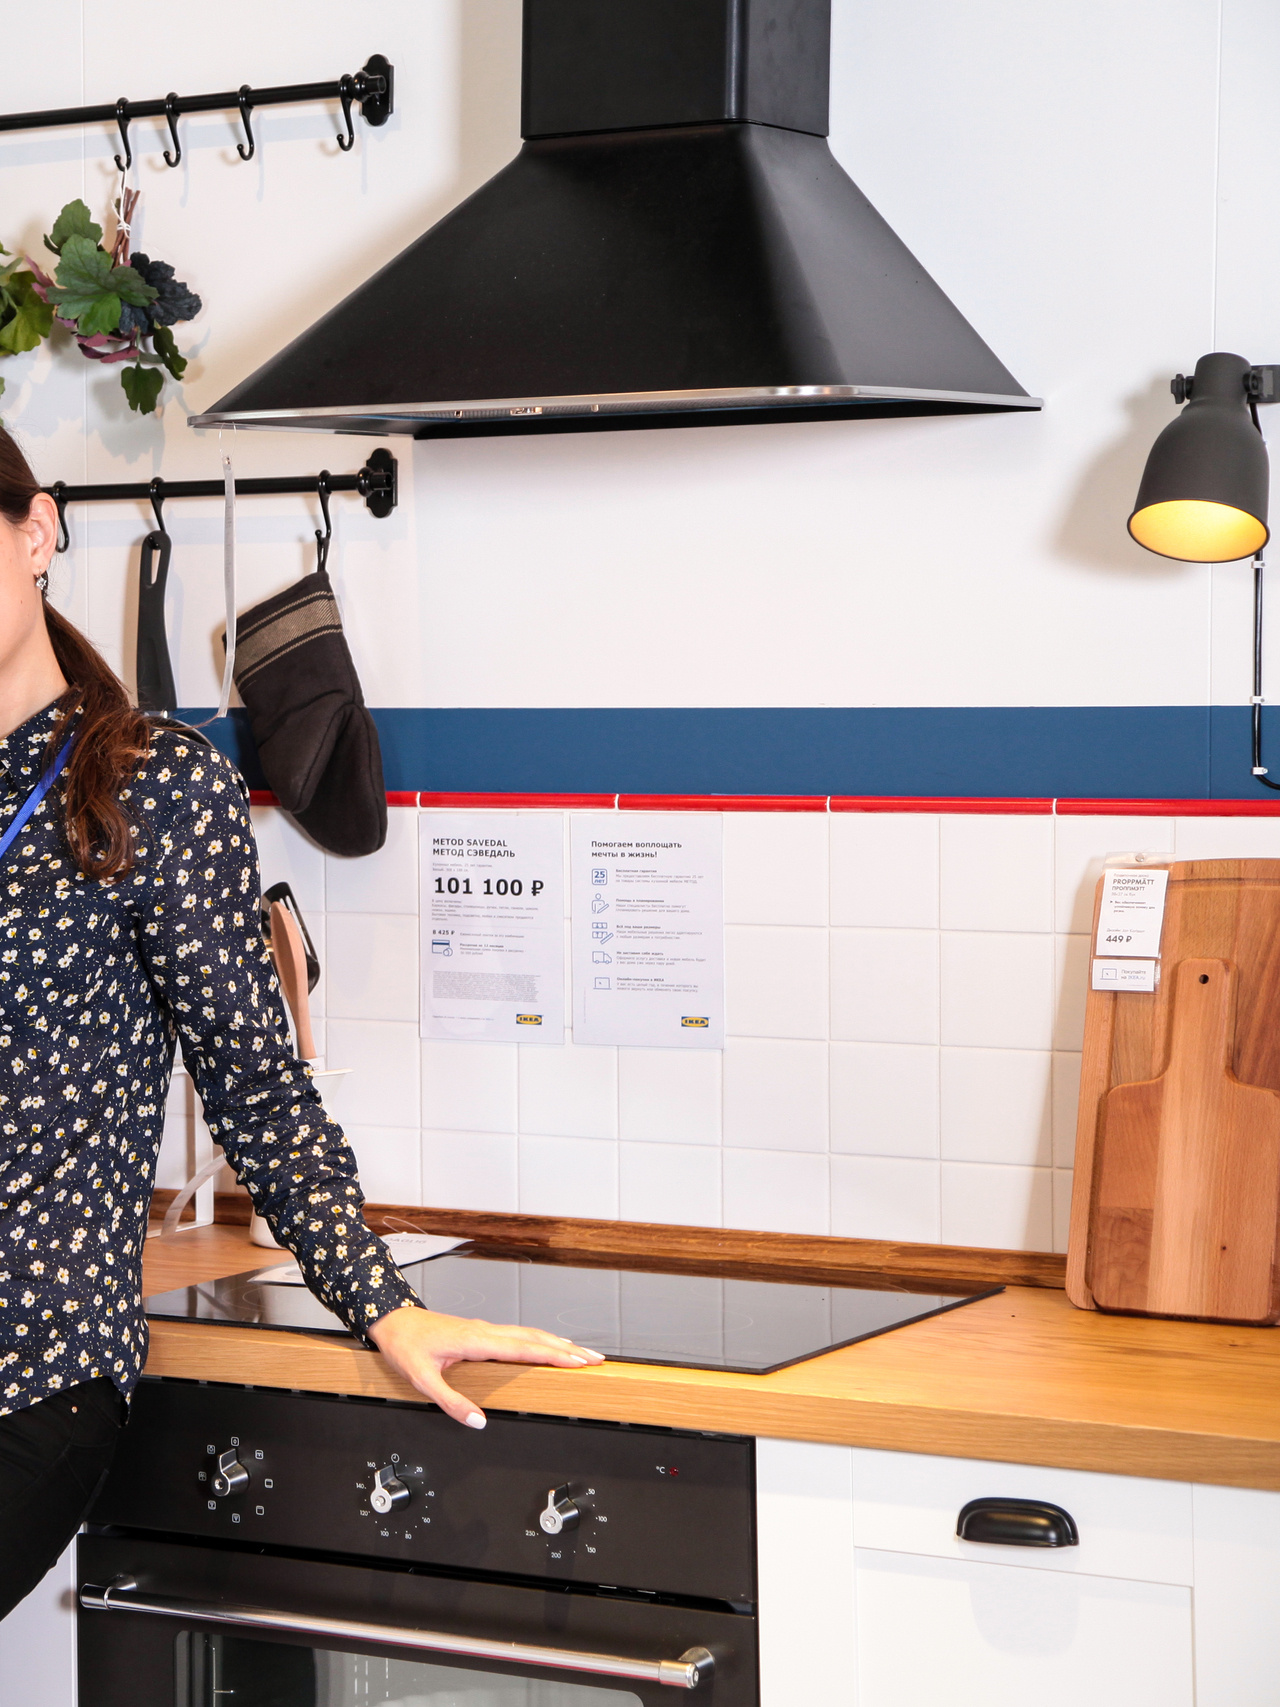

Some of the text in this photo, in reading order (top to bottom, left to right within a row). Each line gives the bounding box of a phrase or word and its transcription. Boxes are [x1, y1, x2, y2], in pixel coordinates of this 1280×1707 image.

[432, 838, 508, 847] METOD SAVEDAL
[432, 848, 516, 858] МЕТОД СЭВЕДАЛЬ
[434, 876, 544, 896] 101 100 ₽
[656, 1465, 666, 1474] °C
